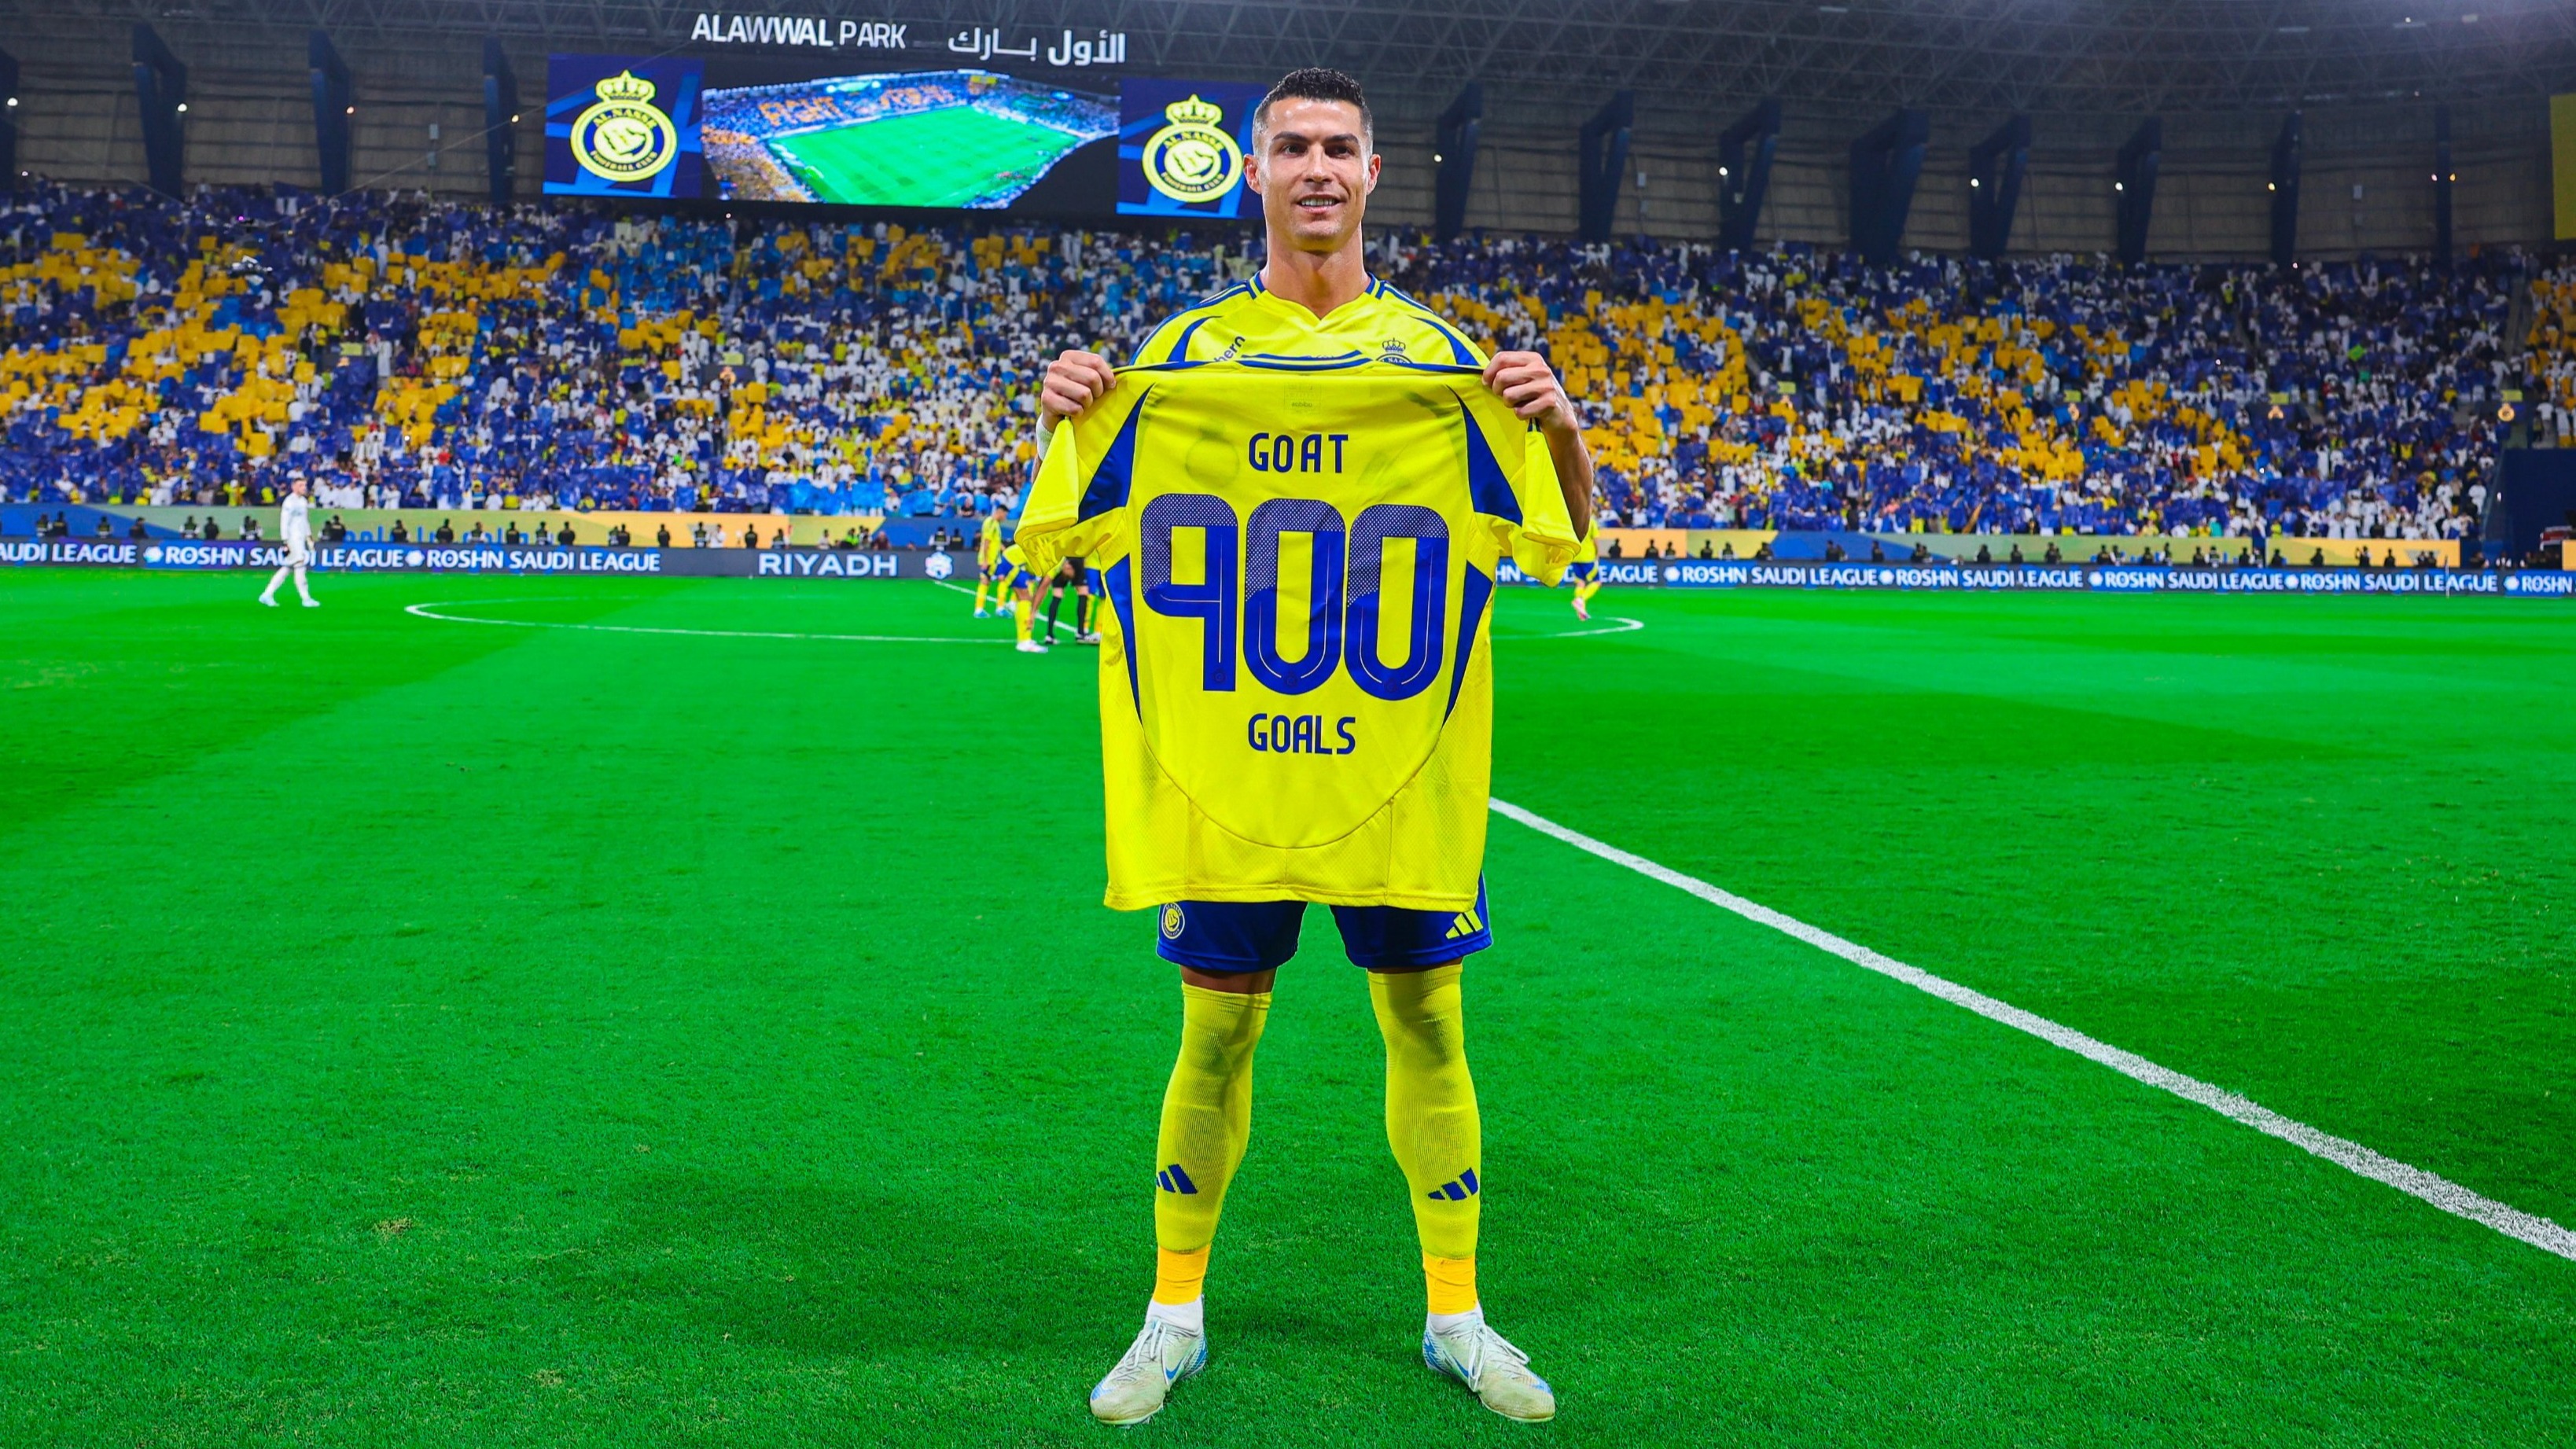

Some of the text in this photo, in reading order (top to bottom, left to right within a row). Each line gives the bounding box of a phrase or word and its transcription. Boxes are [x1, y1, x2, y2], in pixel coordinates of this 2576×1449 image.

[690, 13, 907, 50] ALAWWAL PARK
[1047, 29, 1126, 67] الأول
[1248, 432, 1349, 474] GOAT
[0, 542, 138, 563] AUDI LEAGUE
[165, 546, 245, 565] ROSHN
[322, 549, 404, 568] LEAGUE
[426, 550, 661, 572] ROSHN SAUDI LEAGUE
[758, 553, 898, 576] RIYADH
[1599, 565, 1658, 583] EAGUE
[1682, 566, 1878, 586] ROSHN SAUDI LEAGUE
[1896, 568, 2084, 588] ROSHN SAUDI LEAGUE
[2104, 571, 2284, 590] ROSHN SAUDI LEAGUE
[2301, 572, 2498, 592] ROSHN SAUDI LEAGUE
[2522, 575, 2573, 594] ROSHN
[1140, 493, 1450, 701] 900
[1248, 712, 1356, 756] GOALS
